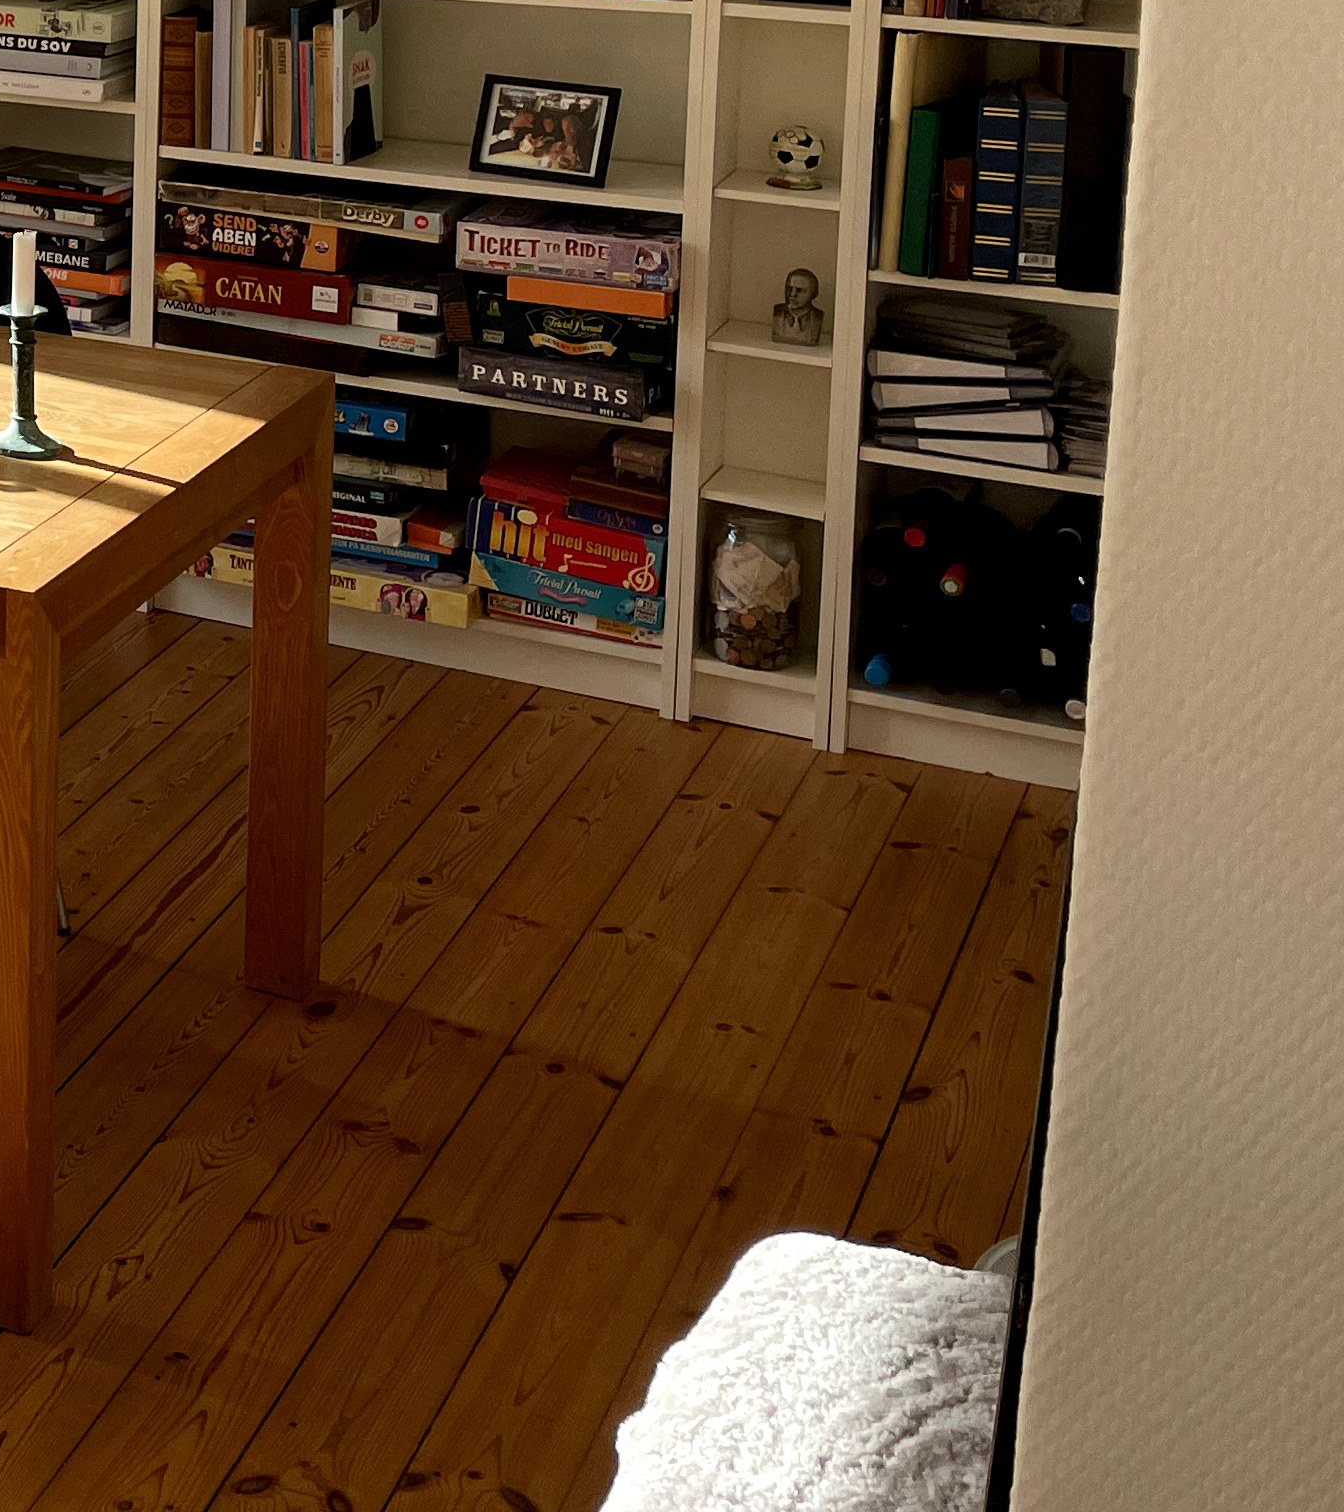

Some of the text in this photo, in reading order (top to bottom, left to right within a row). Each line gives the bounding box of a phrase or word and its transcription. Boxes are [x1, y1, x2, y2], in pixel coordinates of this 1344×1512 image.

[17, 37, 38, 50] DU
[40, 40, 72, 53] SOV
[213, 213, 257, 232] SEND
[341, 205, 395, 227] Derby
[212, 229, 257, 246] ABEN
[464, 229, 611, 261] TICKET TO RIDE
[215, 277, 283, 305] CATAN
[163, 300, 218, 317] MATADOR
[470, 363, 630, 407] PARTNERS
[489, 509, 639, 565] hit med sangen
[528, 570, 602, 600] Trivial Pursuit
[524, 600, 578, 626] DUBLET
